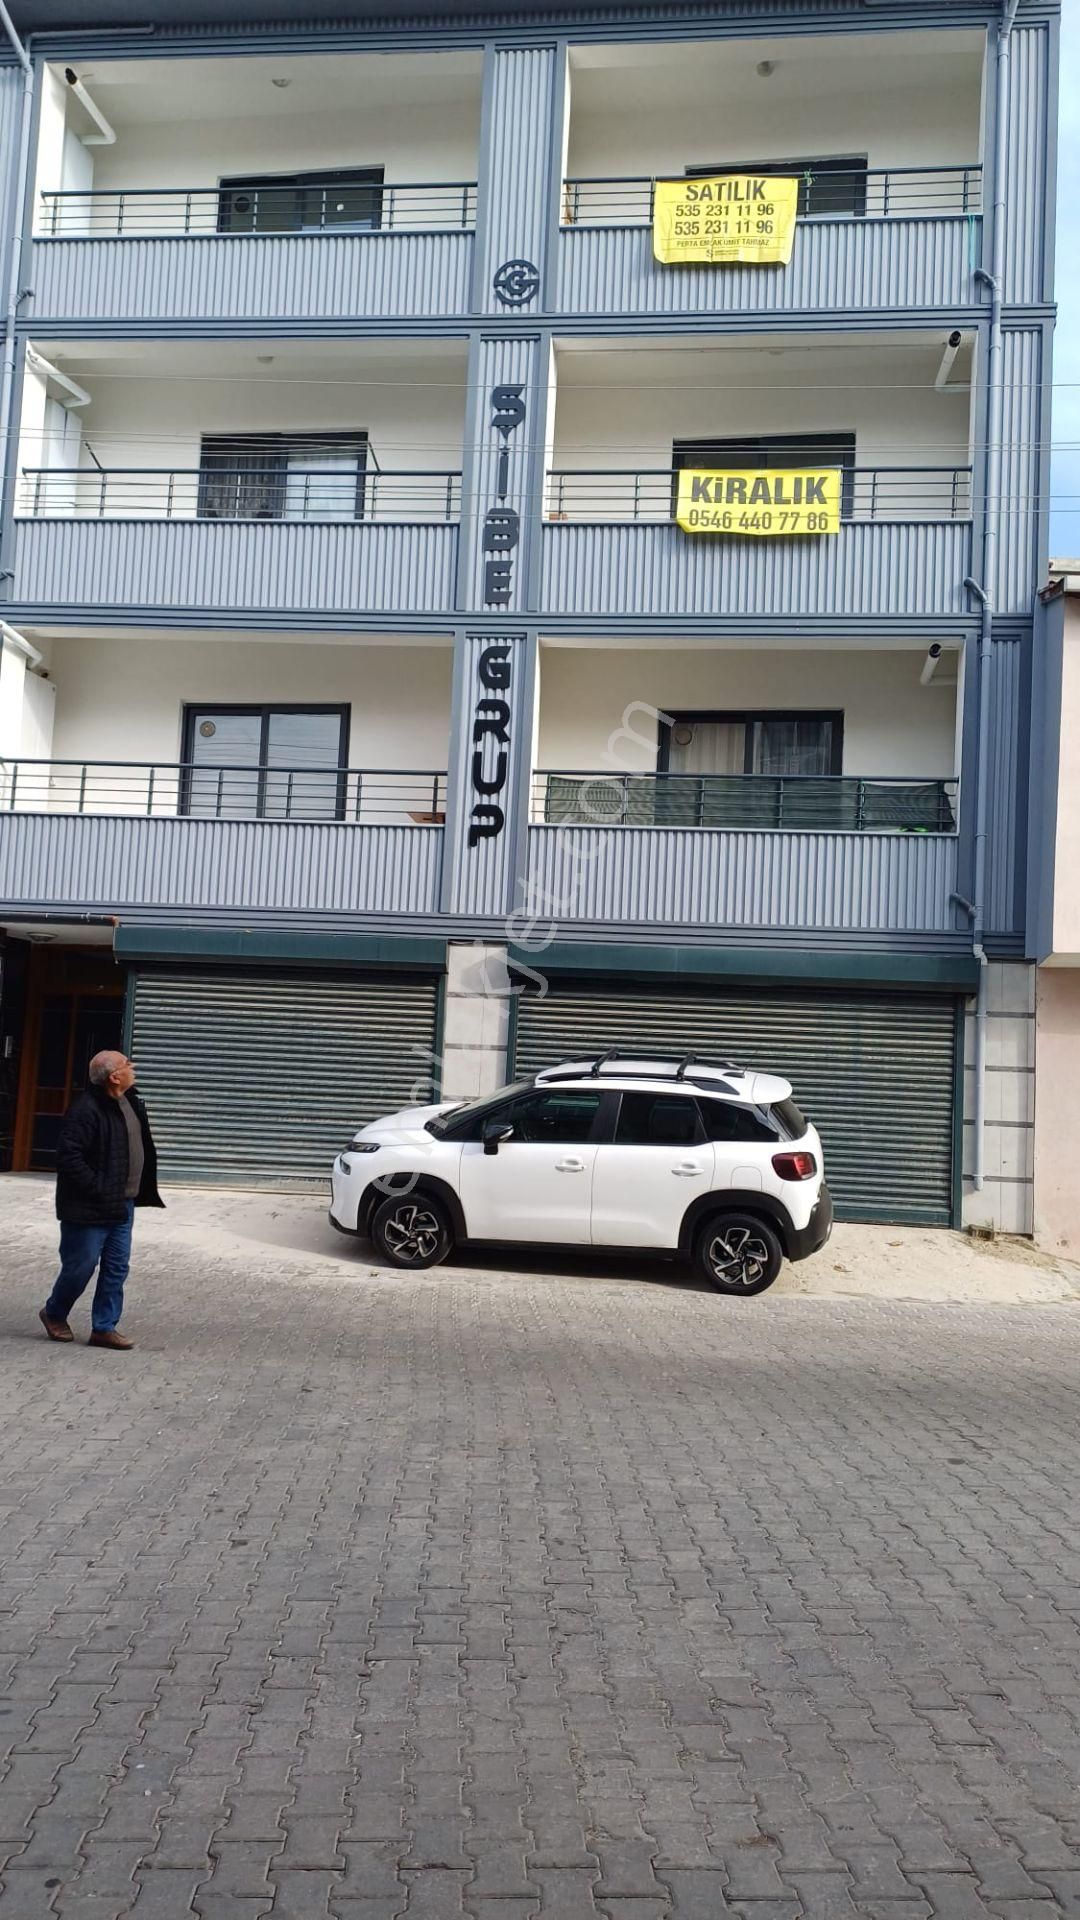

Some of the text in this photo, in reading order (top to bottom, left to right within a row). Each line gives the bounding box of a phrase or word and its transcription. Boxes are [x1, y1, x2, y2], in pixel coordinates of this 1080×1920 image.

[685, 180, 766, 201] SATILIK
[675, 203, 774, 217] 535 231 11 96
[674, 220, 773, 235] 535 231 11 96
[688, 509, 829, 530] 0546 440 77 86
[469, 645, 513, 848] GRUP
